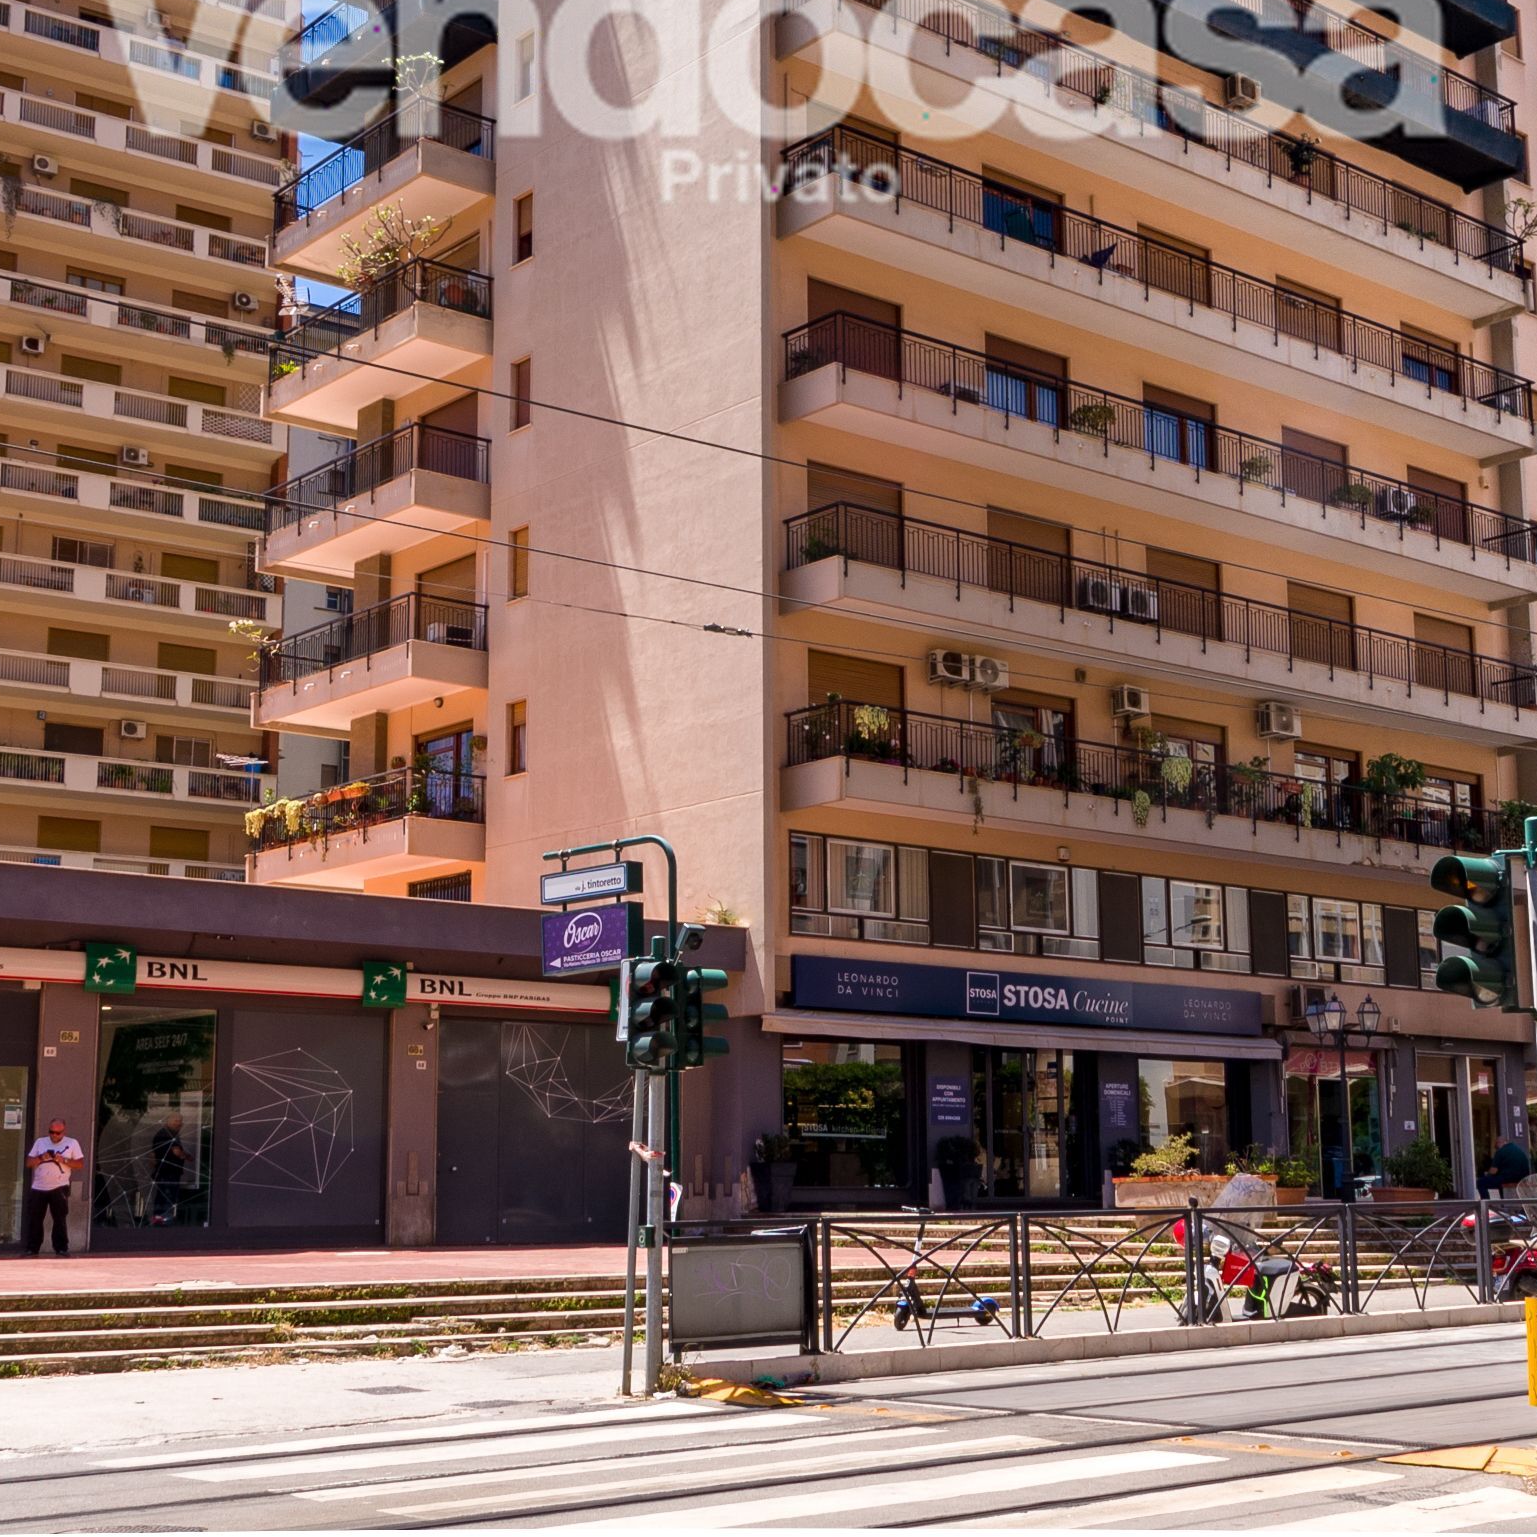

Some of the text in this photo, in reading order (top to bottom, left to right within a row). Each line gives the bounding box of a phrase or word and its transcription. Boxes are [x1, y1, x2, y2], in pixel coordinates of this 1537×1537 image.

[587, 877, 622, 890] tintoretto
[564, 922, 599, 948] Oscar
[563, 952, 600, 963] PASTICCERIA
[600, 948, 622, 959] OSCAR
[146, 961, 208, 982] BNL
[837, 972, 899, 986] LEONARDO
[419, 978, 472, 997] BNL
[476, 991, 502, 999] Gruppo
[837, 985, 899, 998] DA VINCI
[969, 988, 997, 1000] STOSA
[1003, 984, 1129, 1014] STOSA Cucine
[1184, 998, 1232, 1010] LEONARDO
[1105, 1016, 1129, 1024] POINT
[1184, 1009, 1232, 1021] DA VINCI
[136, 1033, 188, 1051] AREA SELF 24/7
[932, 1096, 966, 1104] APPUNTAMENTO
